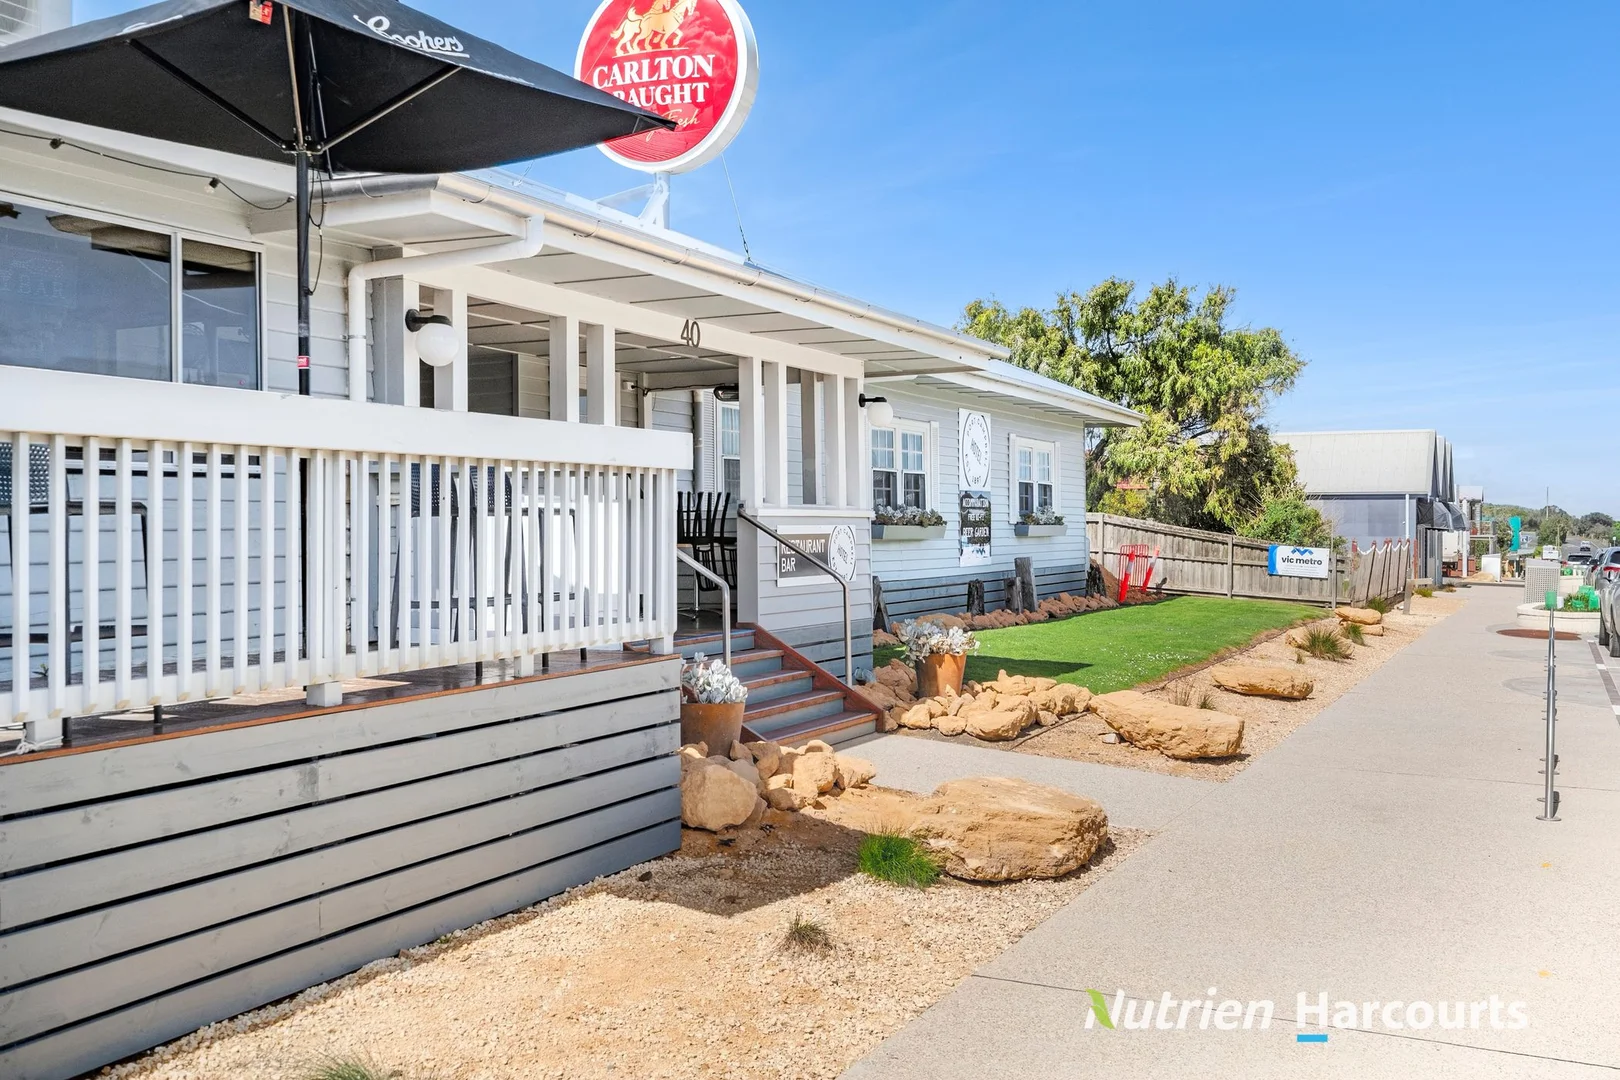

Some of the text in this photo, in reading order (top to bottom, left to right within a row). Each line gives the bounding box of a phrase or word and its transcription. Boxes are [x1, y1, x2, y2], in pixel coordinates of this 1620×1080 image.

[353, 15, 470, 58] Coopers
[592, 54, 716, 89] CARLTON
[612, 82, 710, 107] RAUGHT
[680, 319, 701, 348] 40
[962, 527, 974, 537] BEER
[781, 557, 795, 572] BAR
